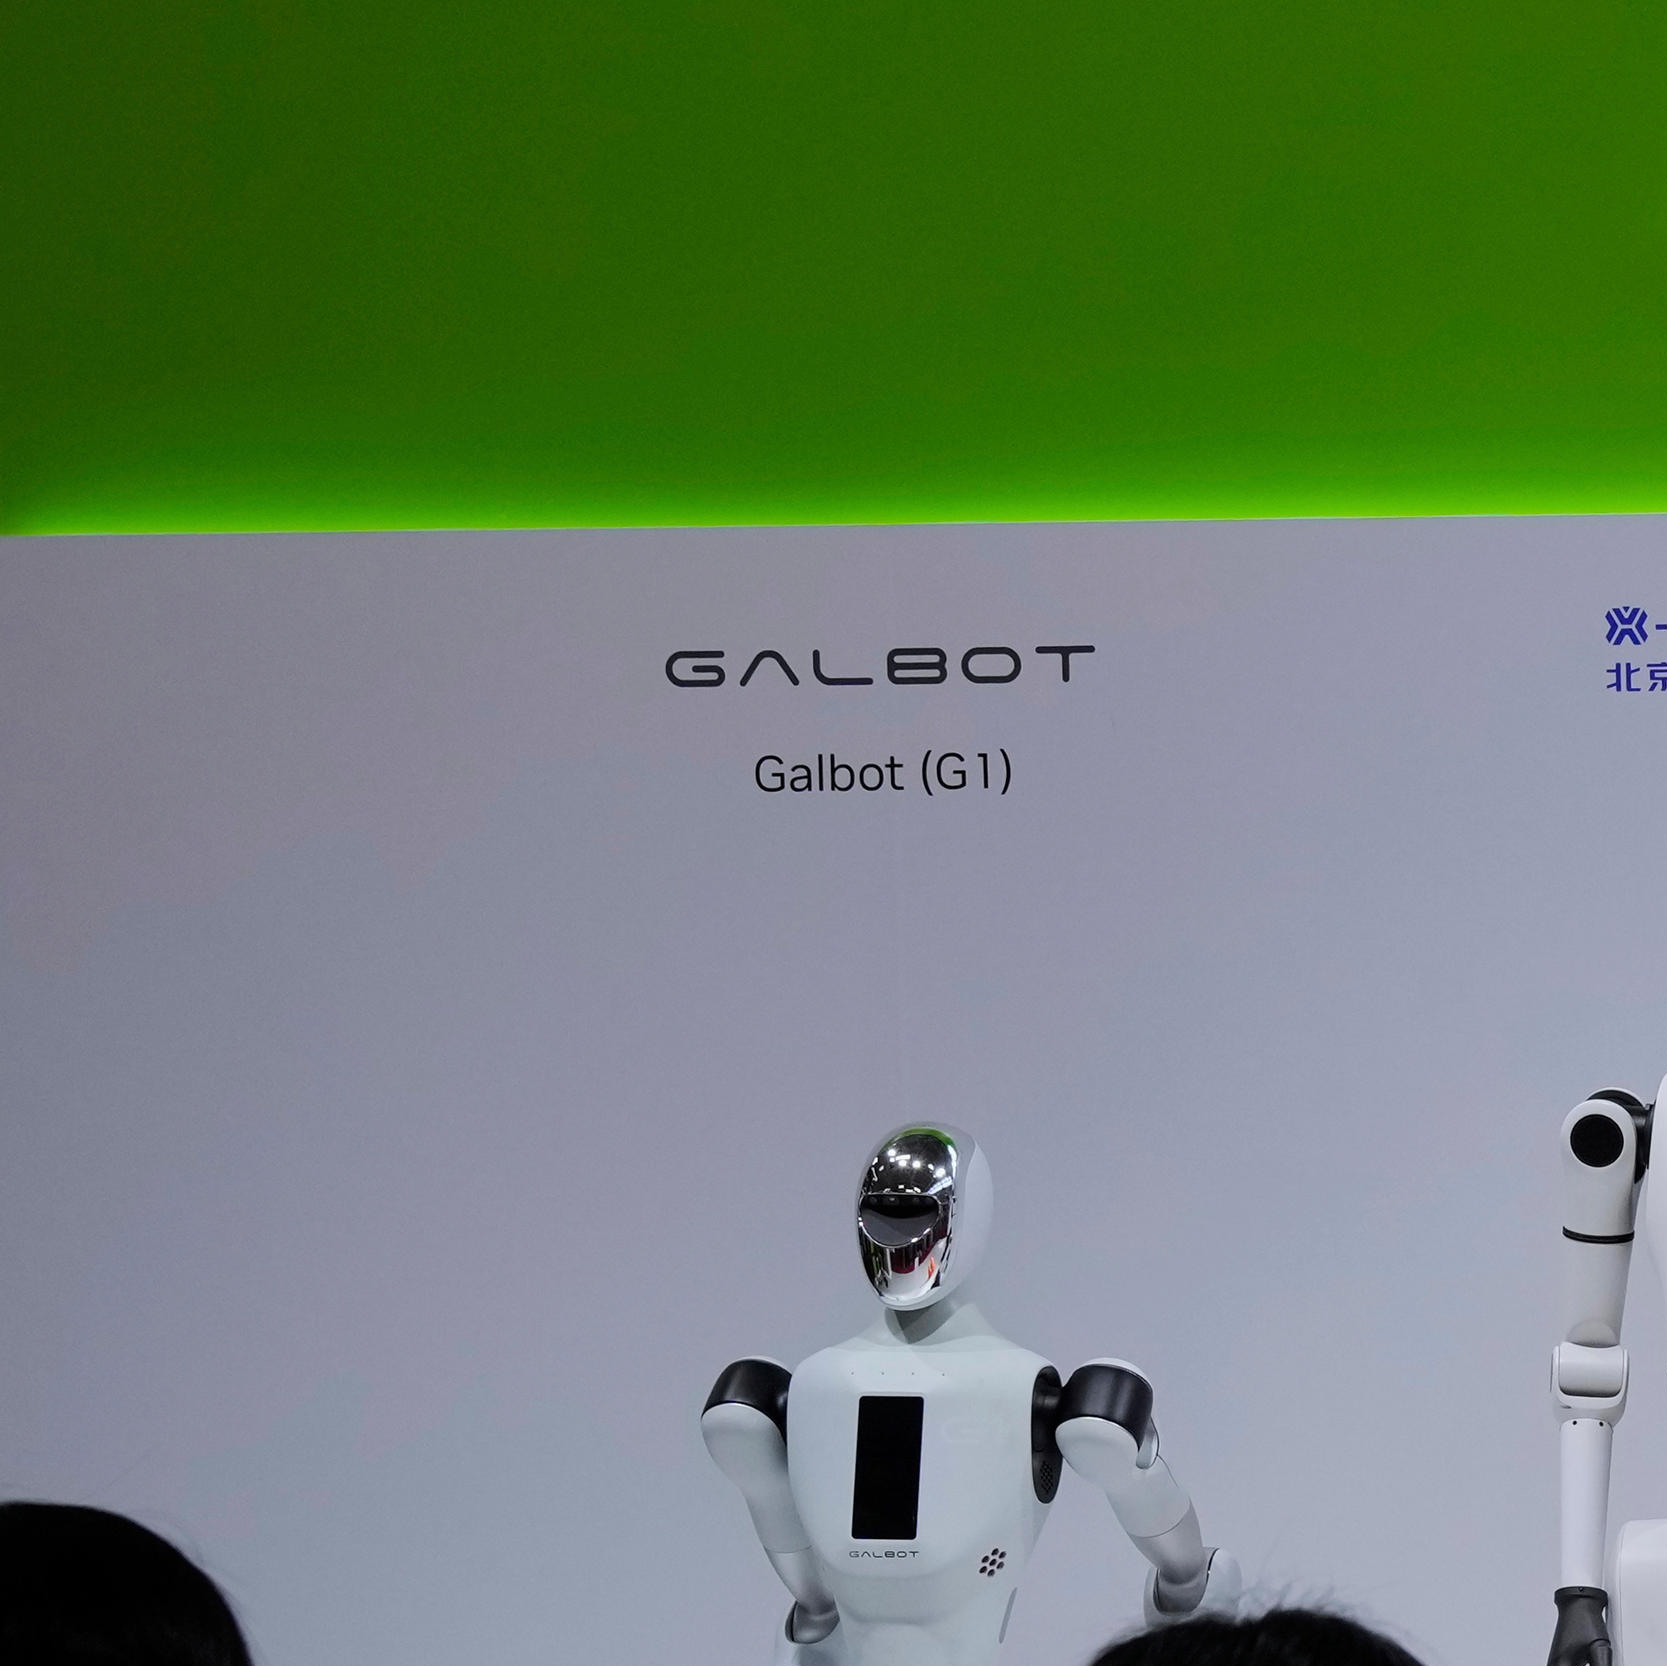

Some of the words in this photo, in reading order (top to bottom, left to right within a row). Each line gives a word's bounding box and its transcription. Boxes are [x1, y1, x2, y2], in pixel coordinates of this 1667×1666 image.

[665, 645, 1096, 688] GALBOT
[754, 752, 904, 793] Galbot
[921, 748, 1012, 796] (G1)
[849, 1550, 920, 1559] GALBOT
